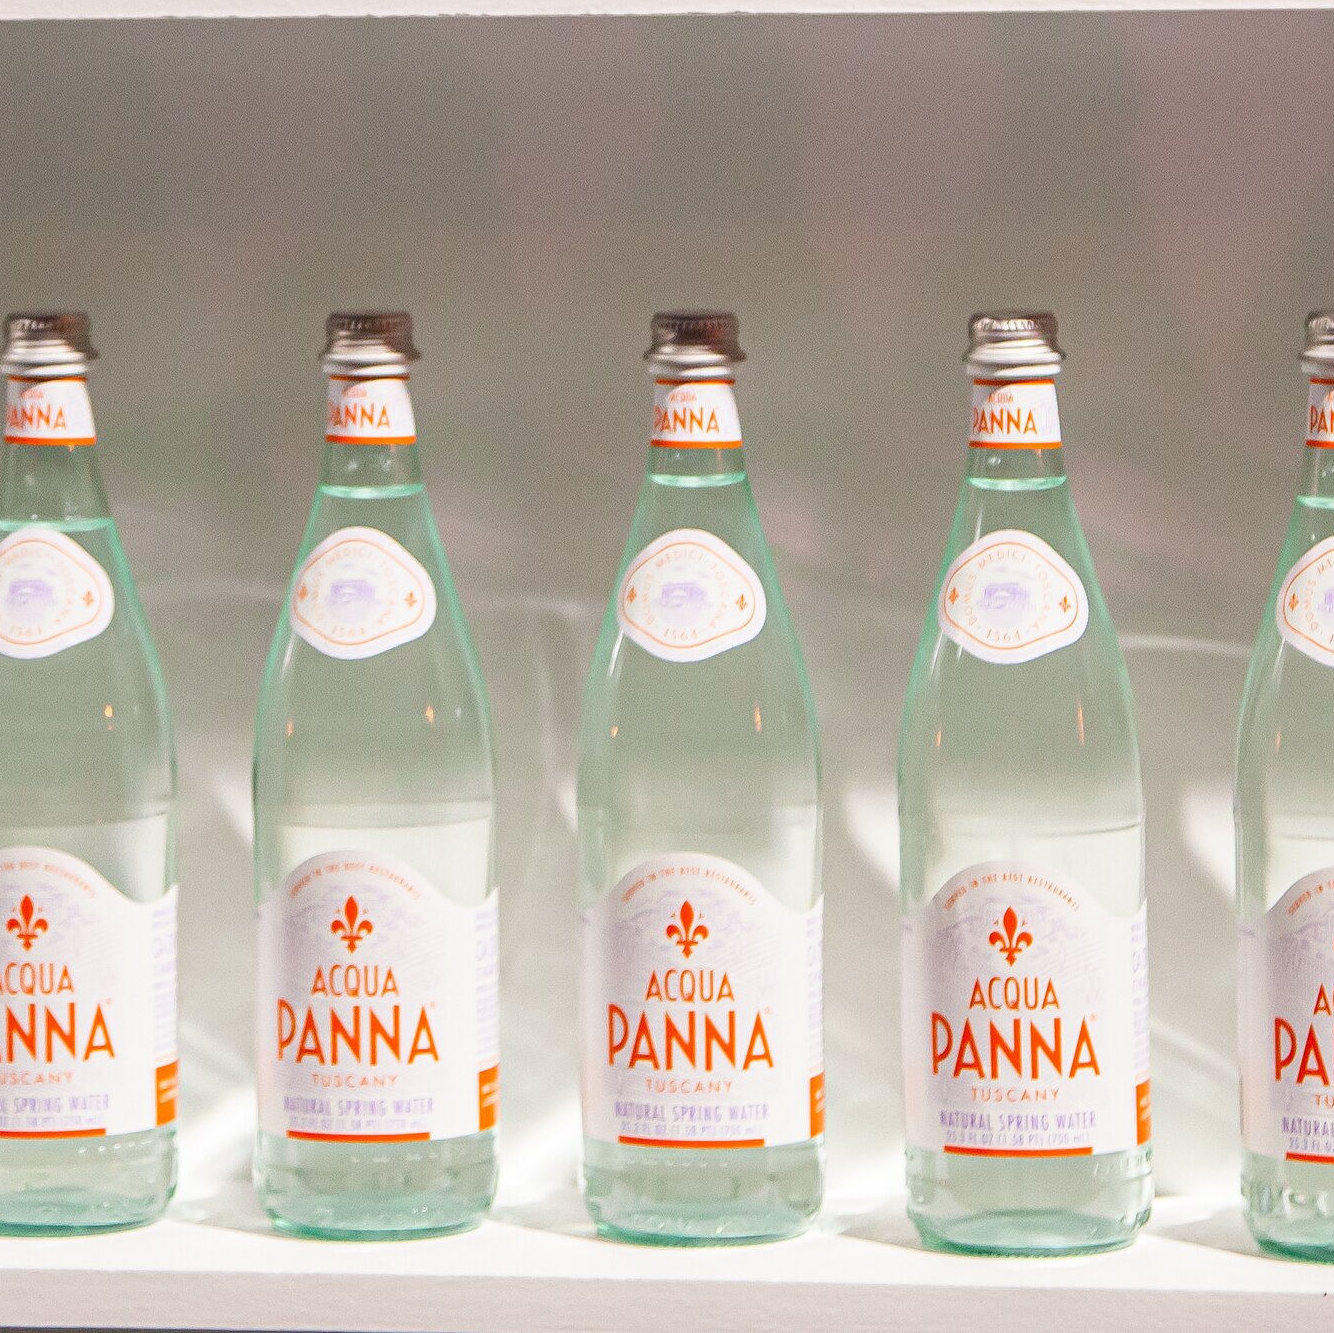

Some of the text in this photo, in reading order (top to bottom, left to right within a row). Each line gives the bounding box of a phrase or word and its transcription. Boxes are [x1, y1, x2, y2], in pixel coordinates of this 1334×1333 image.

[973, 407, 1037, 435] PANNA
[312, 965, 398, 997] ACQUA
[646, 969, 734, 1003] ACQUA
[969, 977, 1059, 1011] ACQUA
[278, 997, 439, 1066] PANNA
[608, 1003, 773, 1072] PANNA
[931, 1010, 1099, 1080] PANNA
[645, 1078, 731, 1095] TUSCANY
[971, 1087, 1058, 1103] TUSCANY
